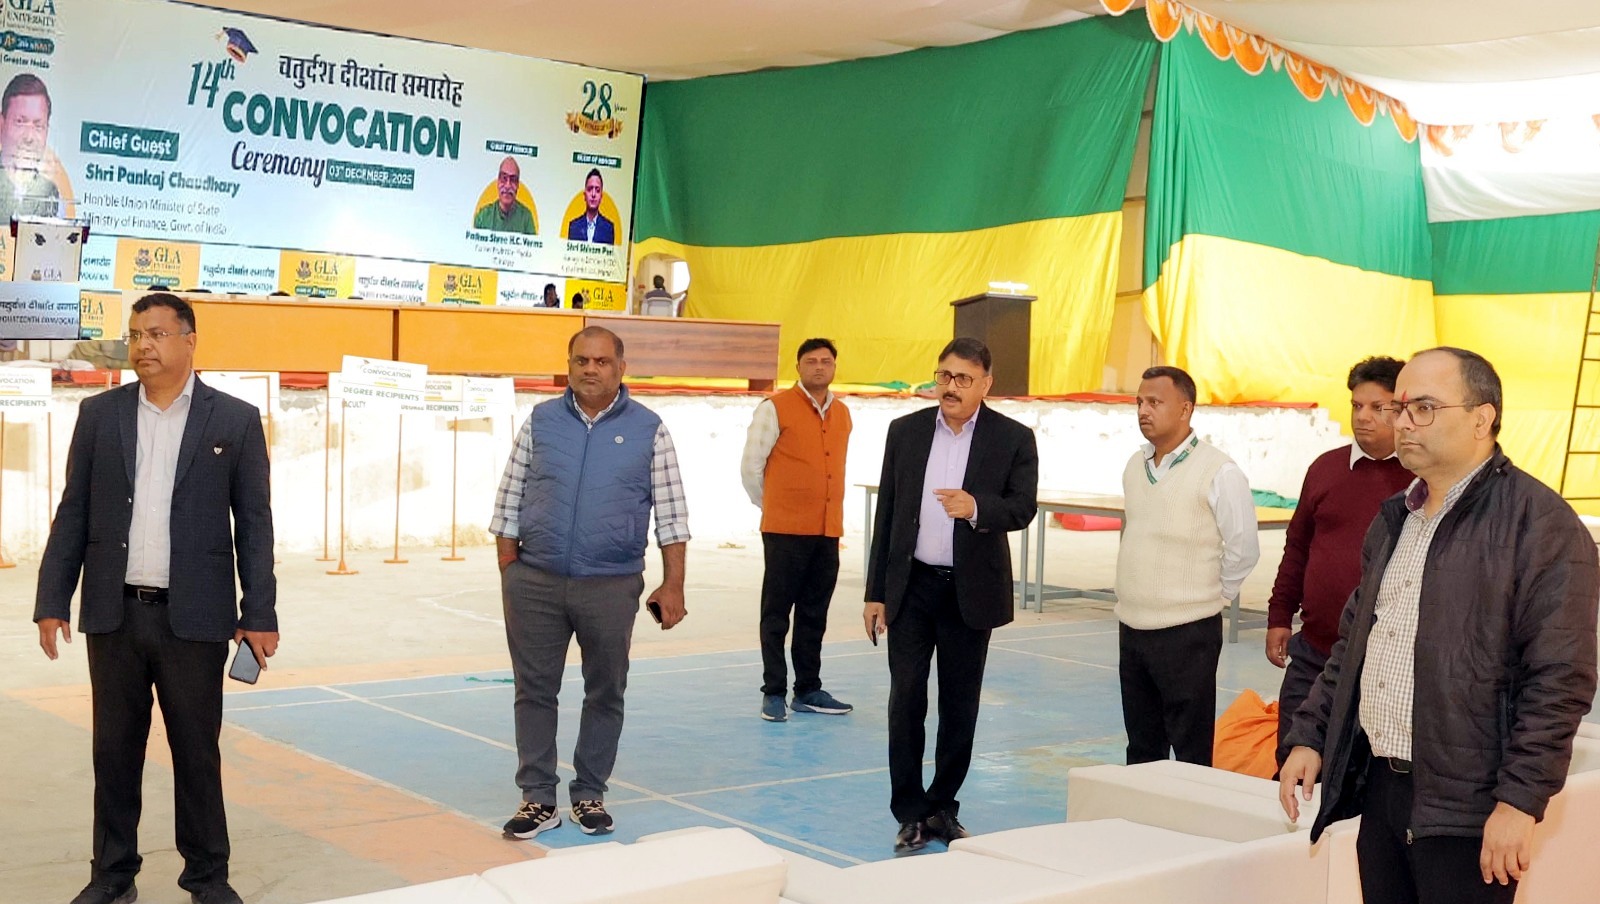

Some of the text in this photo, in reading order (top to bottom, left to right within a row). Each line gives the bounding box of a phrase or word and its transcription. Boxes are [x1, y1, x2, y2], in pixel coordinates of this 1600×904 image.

[188, 58, 235, 108] 14th
[279, 54, 464, 107] चतुर्दश दीक्षांत समारोह
[581, 81, 613, 121] 28
[222, 90, 462, 160] CONVOCATION
[88, 129, 172, 155] Chief Guest
[231, 140, 325, 188] Ceremony
[85, 162, 240, 199] Shri Pankaj Chaudhary
[392, 173, 412, 184] 2025
[84, 192, 221, 217] Hon'ble Union Minister of State
[120, 215, 132, 227] of
[194, 220, 205, 233] of
[205, 222, 227, 235] India
[153, 246, 181, 264] GLA
[567, 242, 579, 252] Shri
[43, 267, 63, 279] GLA
[314, 259, 338, 275] GLA
[460, 273, 483, 289] GLA
[593, 287, 613, 302] GLA
[363, 368, 412, 379] CONVOCATION
[343, 386, 374, 397] DEGREE
[376, 390, 420, 402] RECIPIENTS
[0, 399, 47, 407] RECIPIENTS
[343, 400, 366, 409] ACULTY
[425, 404, 460, 412] RECIPIENTS
[469, 405, 487, 413] GUEST
